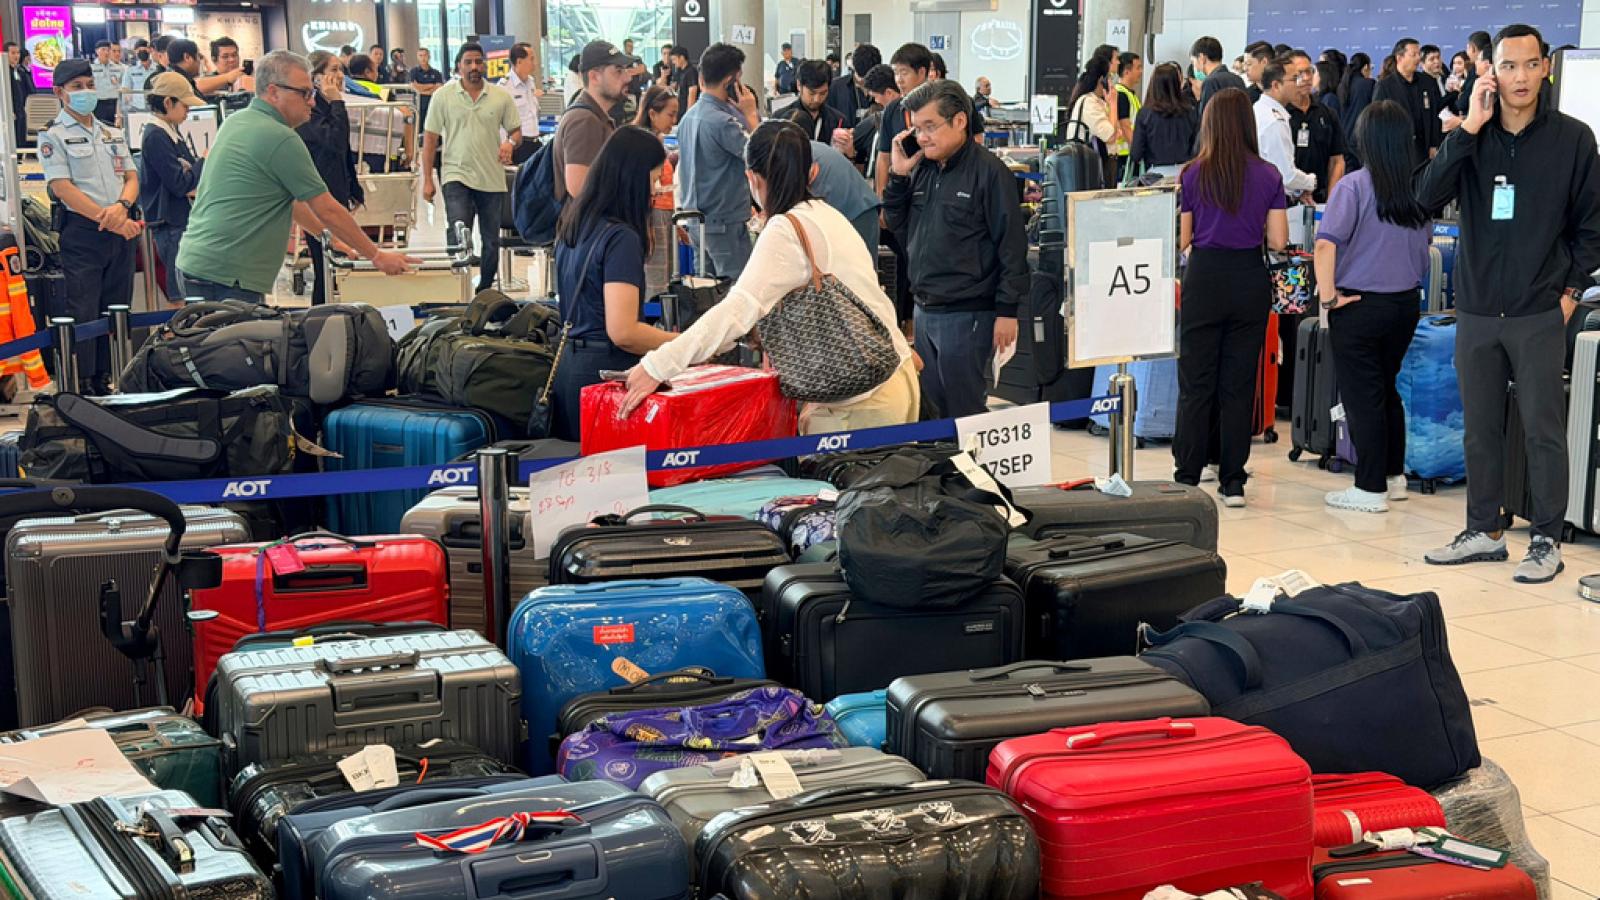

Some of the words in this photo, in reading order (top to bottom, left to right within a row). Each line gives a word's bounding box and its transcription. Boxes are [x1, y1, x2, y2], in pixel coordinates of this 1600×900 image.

[735, 29, 752, 41] A4
[1112, 25, 1126, 35] A4
[1032, 105, 1055, 123] A4
[1108, 263, 1151, 297] A5
[1091, 397, 1121, 413] AOT
[816, 433, 852, 451] AOT
[977, 422, 1032, 449] TG318
[661, 450, 701, 467] AOT
[981, 453, 1034, 477] 7SEP
[427, 466, 474, 485] AOT
[586, 460, 612, 483] 318
[222, 479, 272, 497] AOT
